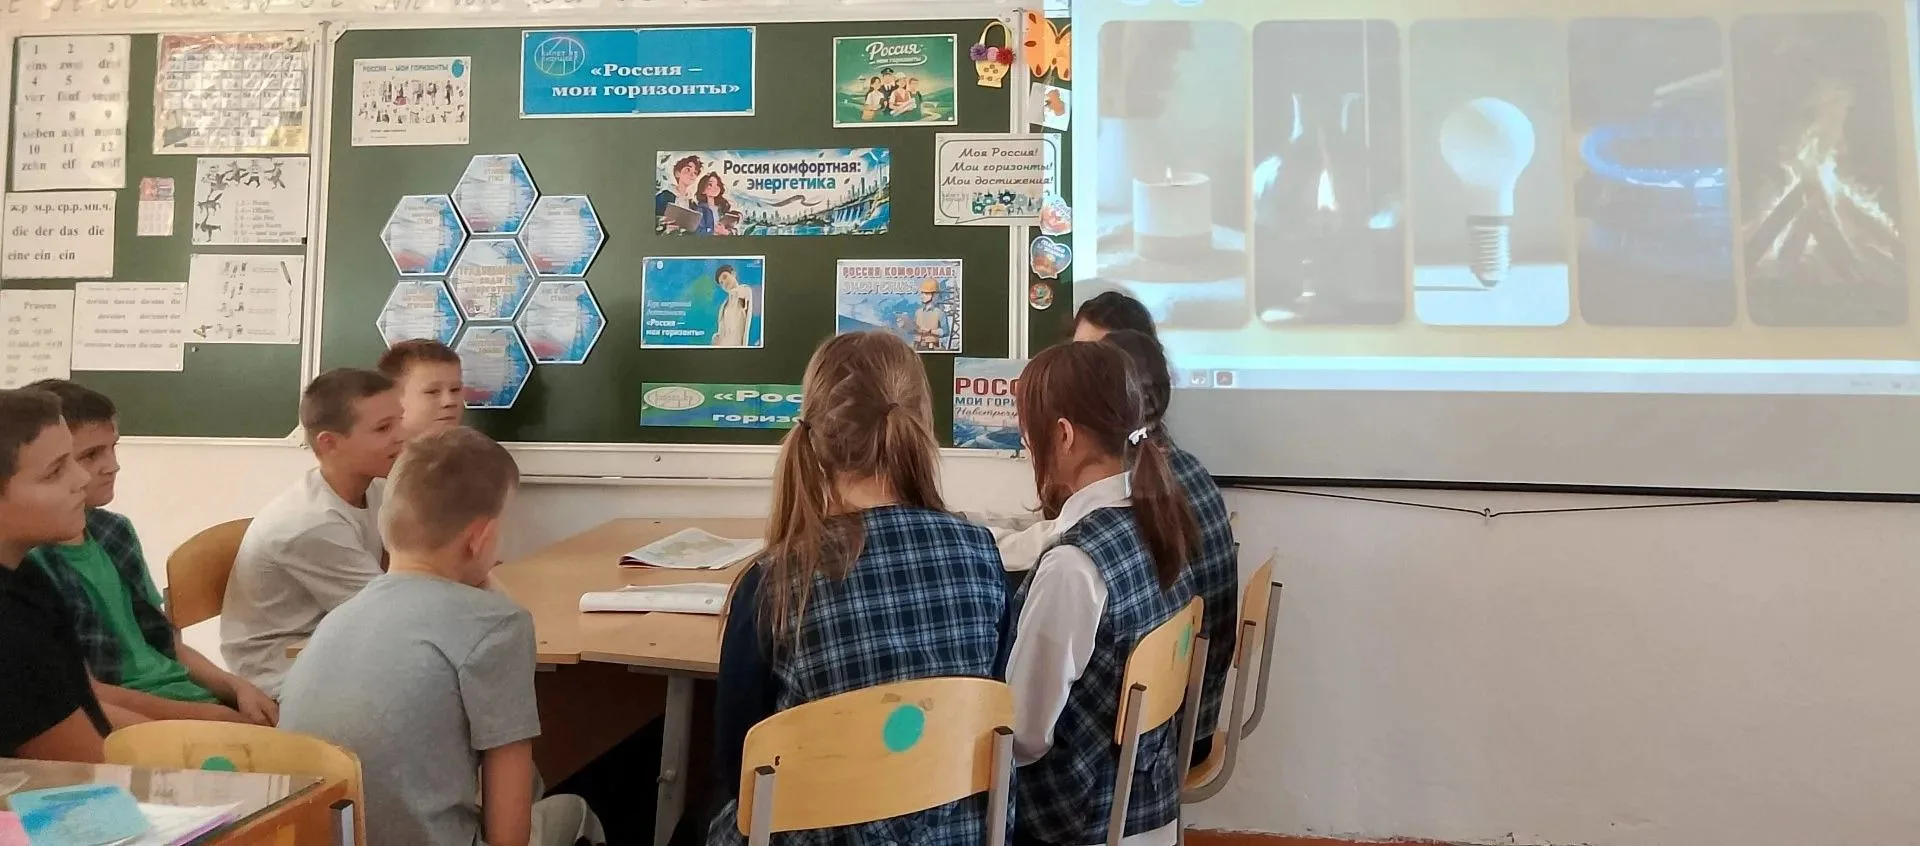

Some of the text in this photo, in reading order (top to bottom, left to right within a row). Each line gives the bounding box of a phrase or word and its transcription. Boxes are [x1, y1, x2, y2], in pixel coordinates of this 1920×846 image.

[68, 43, 73, 54] 2
[108, 42, 114, 52] 3
[865, 42, 921, 60] Россия
[59, 61, 83, 70] zw
[98, 59, 121, 69] dri
[590, 63, 682, 77] «Россия
[65, 75, 72, 85] 5
[552, 84, 741, 98] мои горизонты»
[69, 111, 76, 120] 8
[104, 110, 112, 118] 9
[29, 142, 114, 154] 10 11 12
[958, 147, 1039, 158] Моя Россия!
[62, 159, 76, 169] elf
[91, 158, 122, 168] zwlf
[723, 160, 862, 177] Россия комфортная:
[950, 162, 1053, 173] Мои горизонты!
[746, 176, 836, 193] энергетика
[942, 176, 1054, 186] Мои достижения!
[12, 225, 105, 236] die der das die
[8, 249, 76, 260] eine ein ein
[843, 266, 955, 277] РОССИЯ КОМФОРТНАЯ:
[955, 397, 983, 406] МОИ
